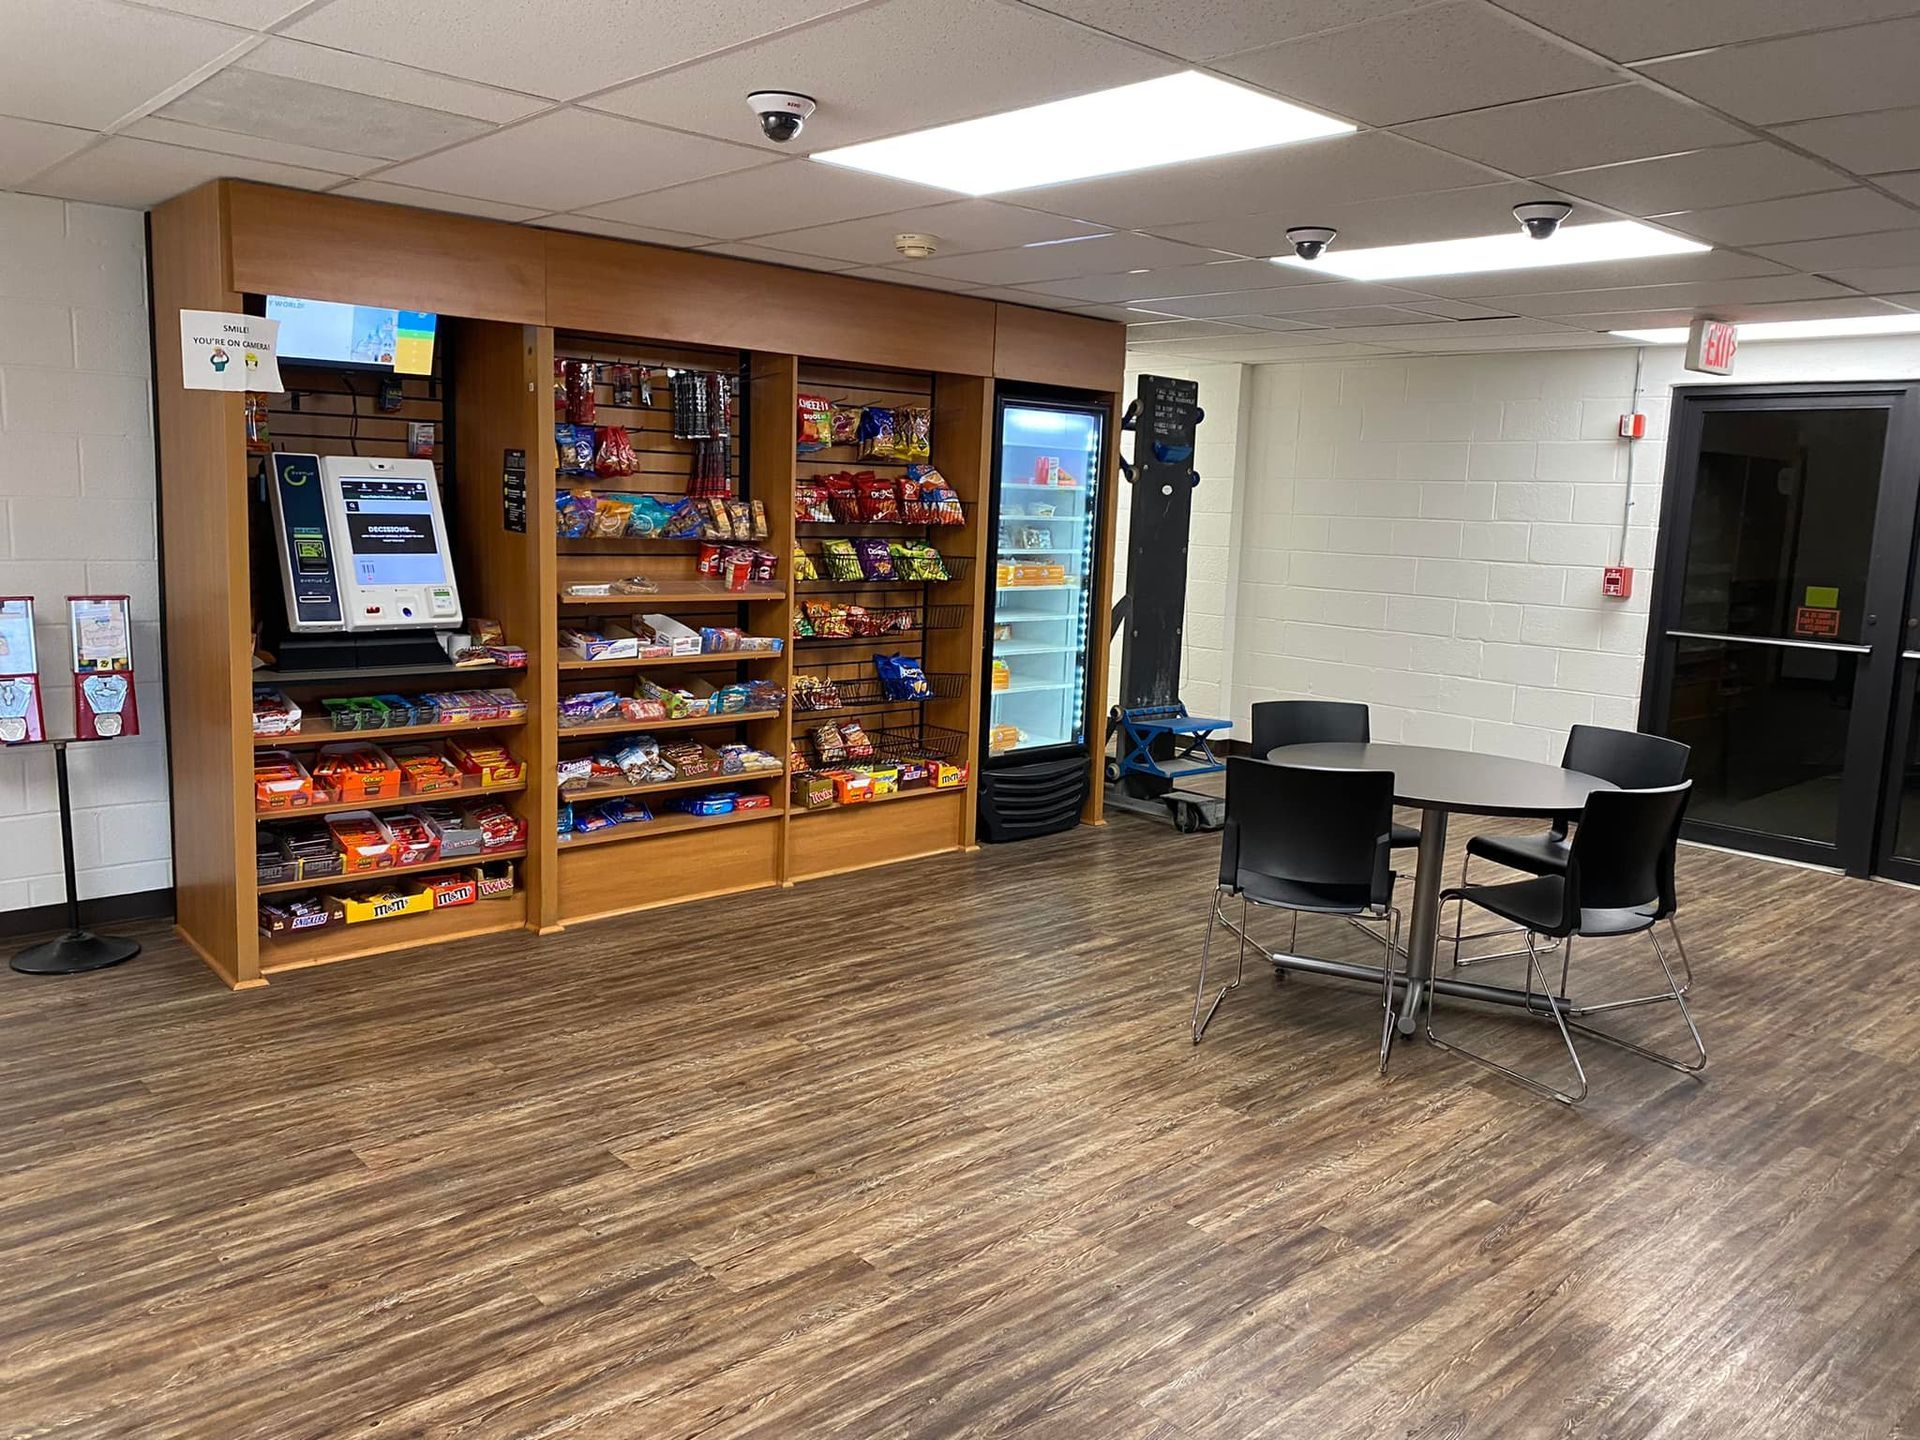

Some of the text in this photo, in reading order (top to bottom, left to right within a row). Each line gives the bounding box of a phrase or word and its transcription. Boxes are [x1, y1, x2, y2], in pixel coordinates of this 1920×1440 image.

[223, 325, 250, 334] SMILE!
[193, 337, 271, 351] YOU'RE ON CAMERA!
[1705, 323, 1734, 368] EXIT
[294, 914, 328, 927] SNICKERS
